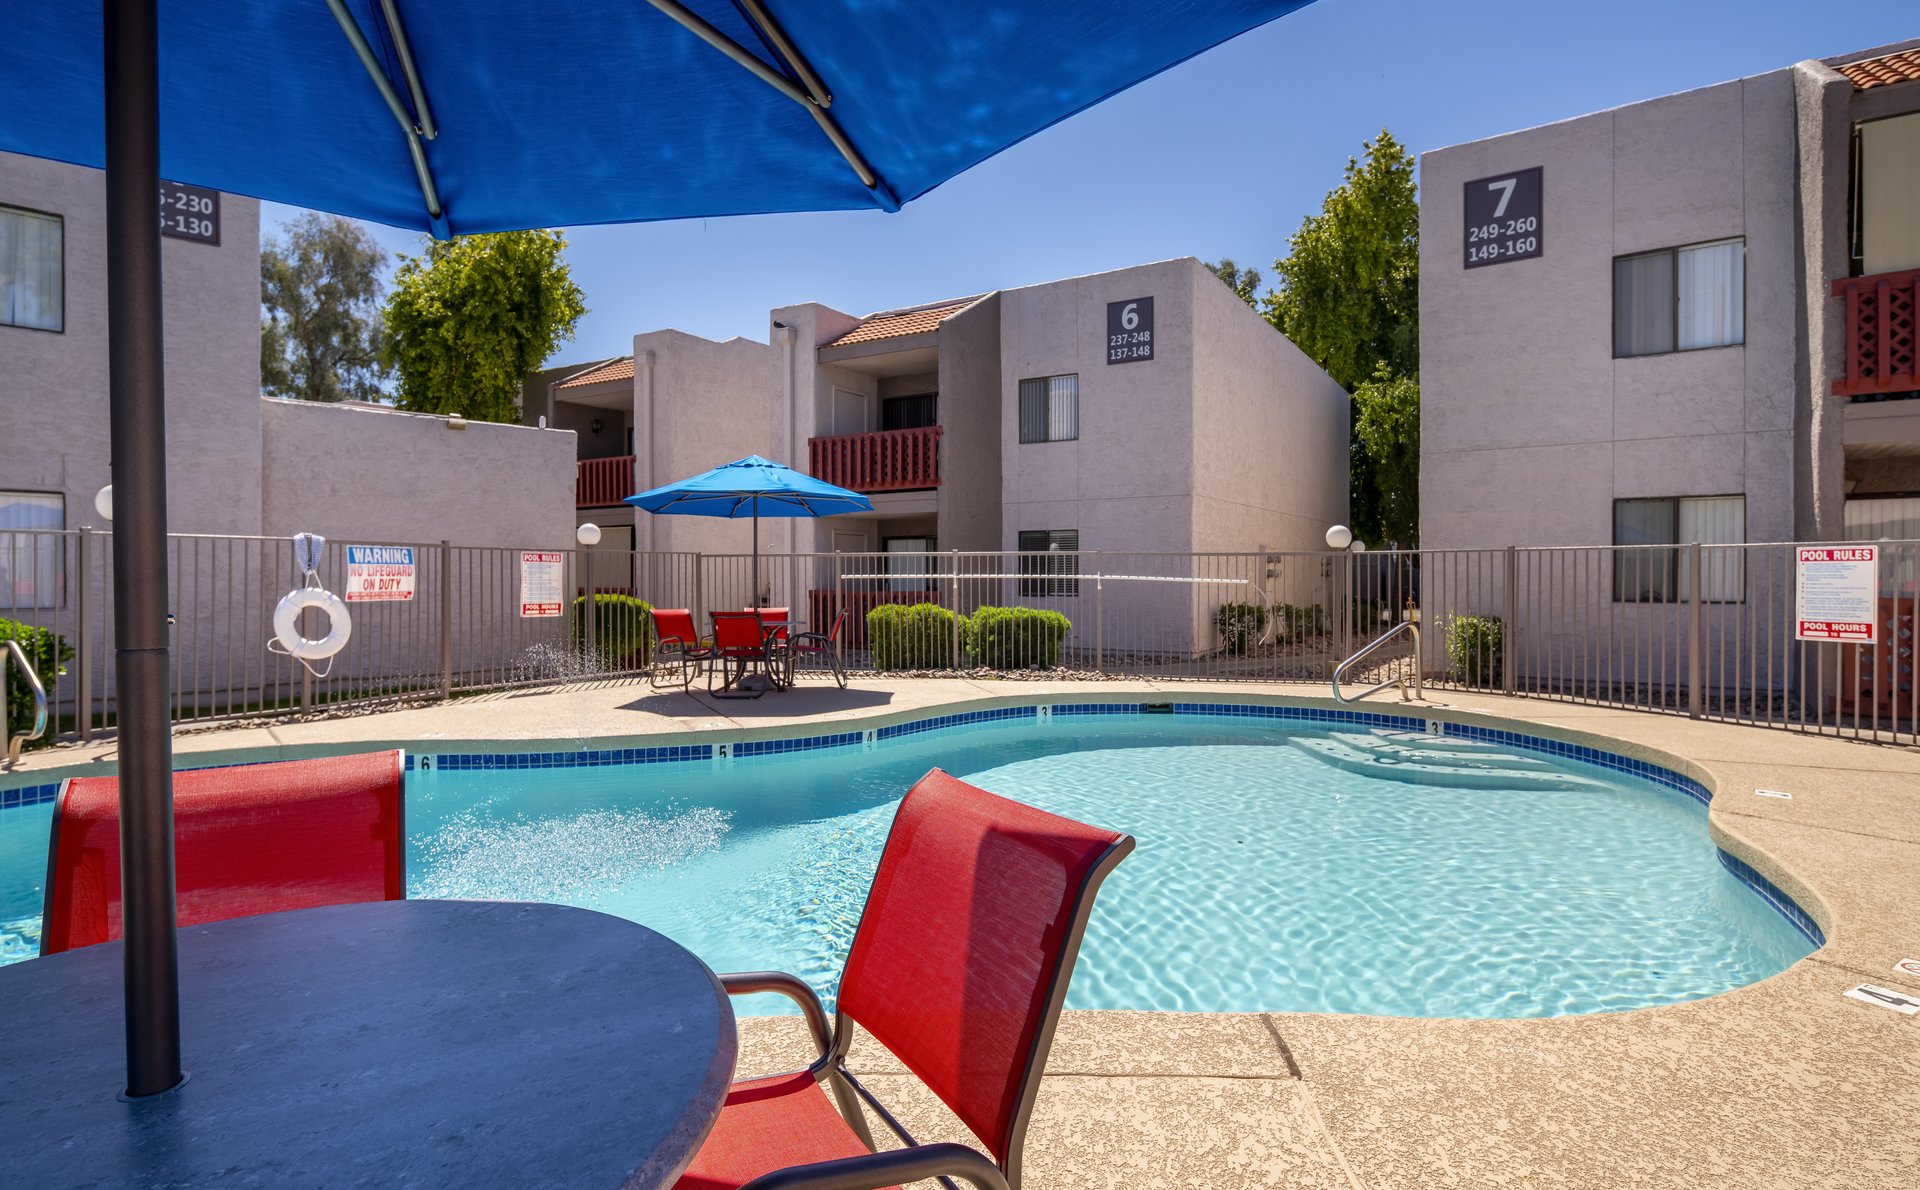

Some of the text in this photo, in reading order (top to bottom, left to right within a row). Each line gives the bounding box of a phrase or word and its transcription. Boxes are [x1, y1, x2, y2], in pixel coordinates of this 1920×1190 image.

[1488, 178, 1517, 218] 7
[1469, 216, 1537, 242] 249-260
[1469, 236, 1537, 262] 149-160
[1121, 303, 1139, 330] 6
[1110, 331, 1150, 346] 237-248
[1110, 345, 1150, 360] 137-148
[352, 547, 410, 564] WARNING
[1801, 549, 1871, 561] POOL RULES
[350, 565, 413, 577] NO LIFEGUARD
[363, 578, 402, 590] ON DUTY
[1803, 622, 1867, 632] POOL HOURS
[719, 745, 727, 758] 5
[421, 755, 430, 770] 6
